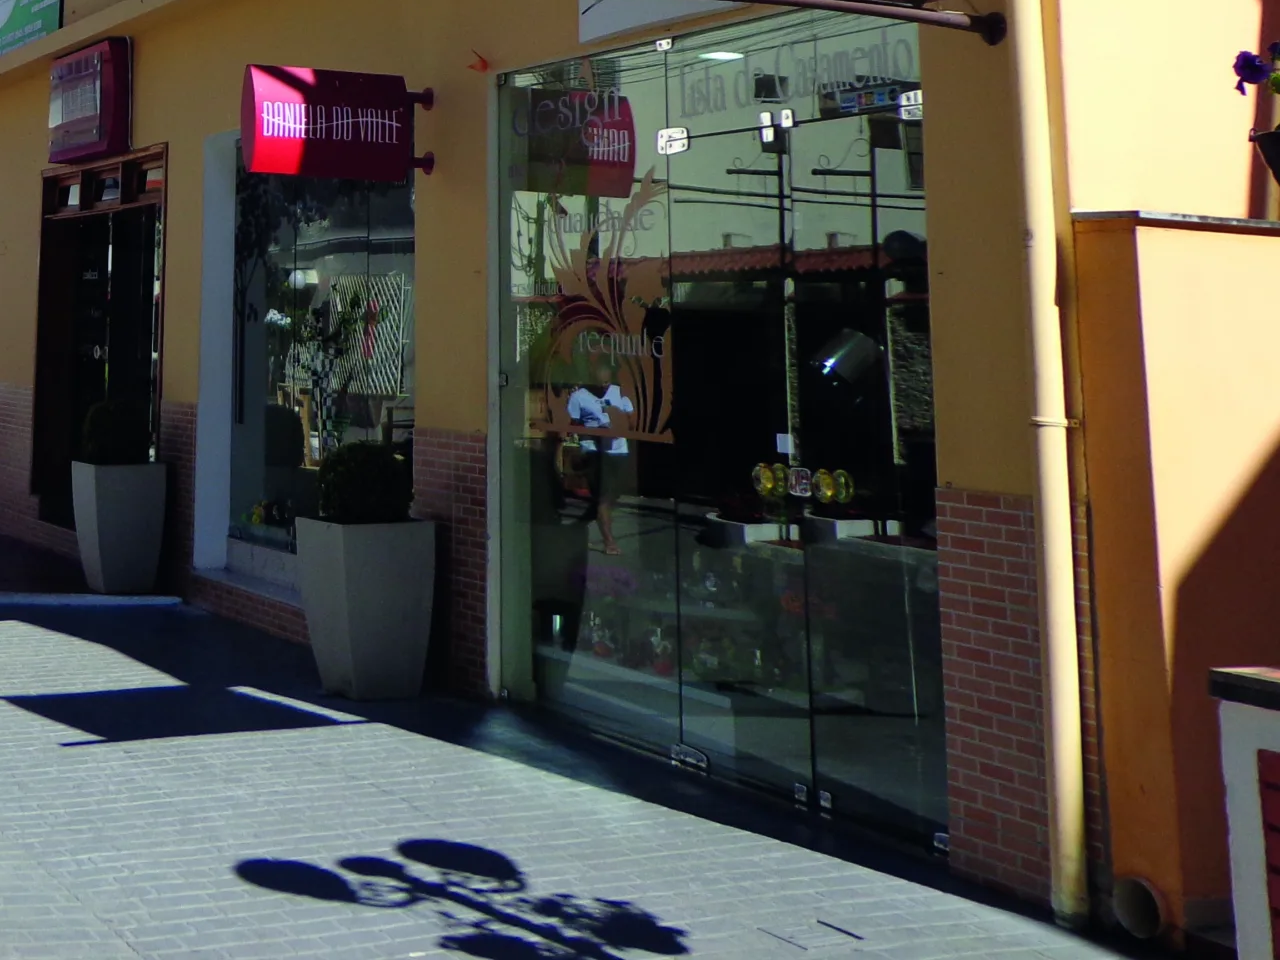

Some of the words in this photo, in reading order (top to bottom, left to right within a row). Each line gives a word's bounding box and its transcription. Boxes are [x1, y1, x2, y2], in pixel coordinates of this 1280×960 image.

[680, 65, 727, 118] Lista
[734, 50, 765, 108] de
[775, 28, 914, 103] Casamento
[262, 101, 326, 139] DANIELA
[358, 107, 399, 144] VALLE
[513, 84, 622, 148] design
